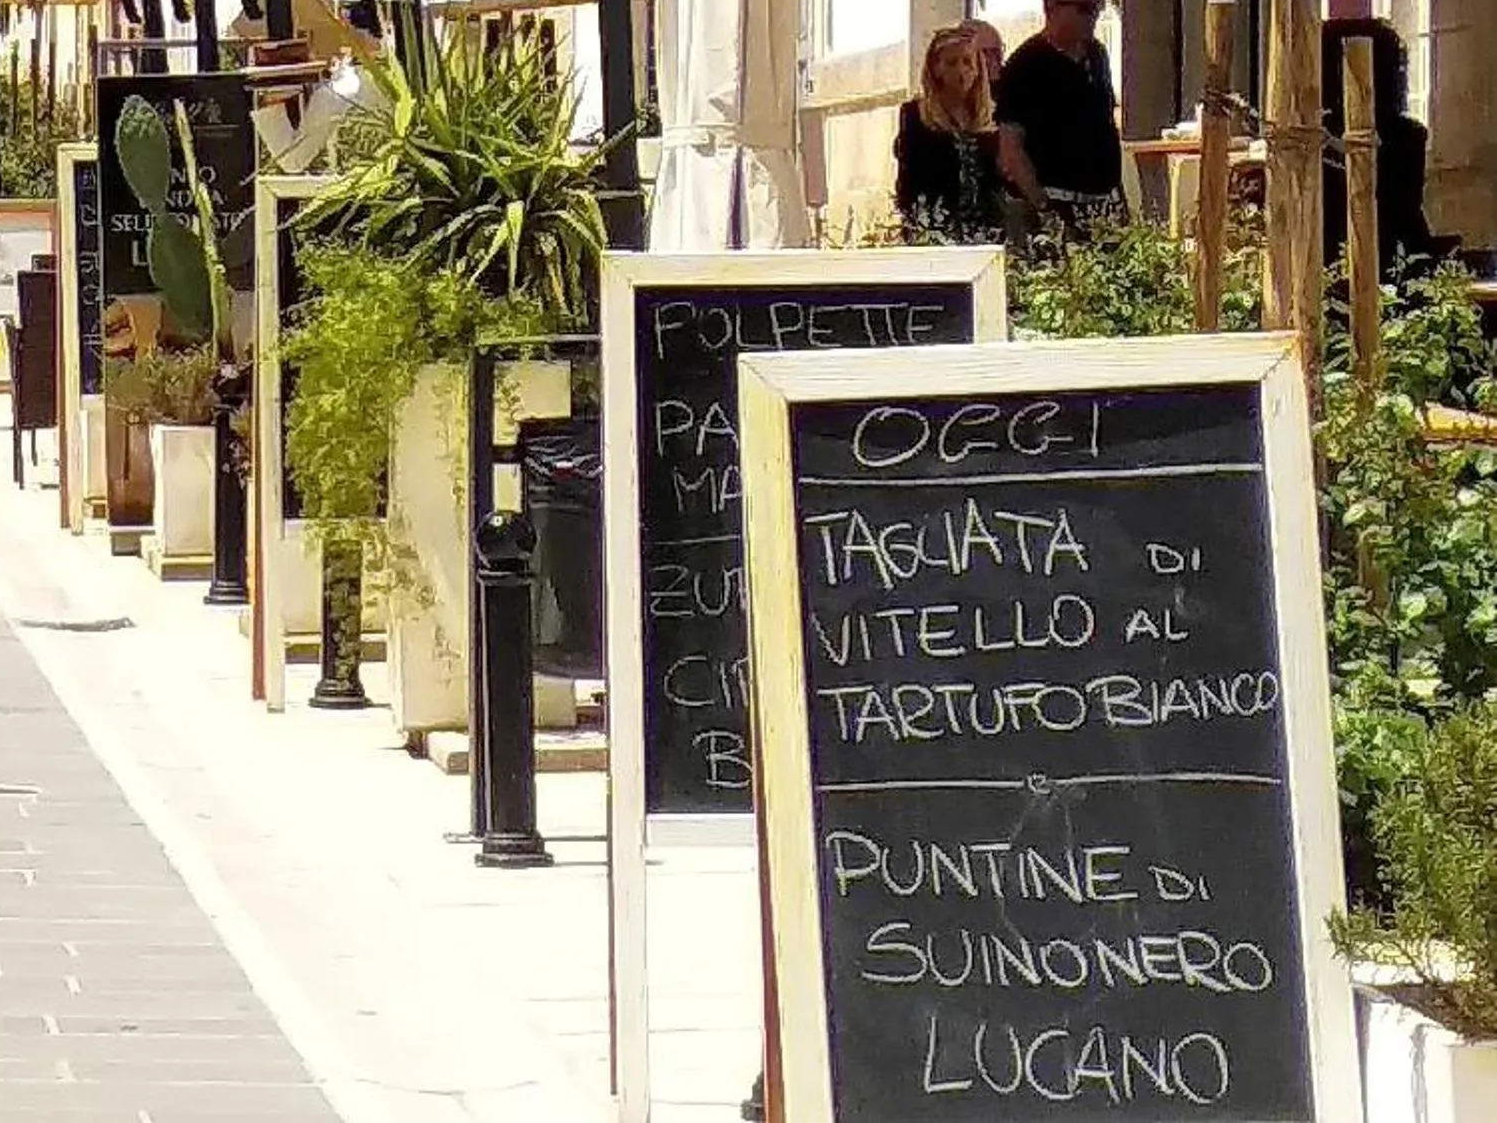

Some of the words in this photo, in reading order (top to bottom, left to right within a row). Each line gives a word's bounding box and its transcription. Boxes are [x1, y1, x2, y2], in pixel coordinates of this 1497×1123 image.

[852, 401, 1100, 468] OGGI
[804, 497, 1090, 591] TAGLIATA
[1144, 540, 1203, 577] DI
[810, 594, 1096, 667] VITELLO
[1125, 608, 1190, 643] AL
[817, 683, 1087, 744] TARTUFO
[1086, 670, 1279, 727] BIANCO
[826, 830, 1140, 905] PUNTINE
[1148, 865, 1211, 902] DI
[923, 1011, 1230, 1105] LUCANO
